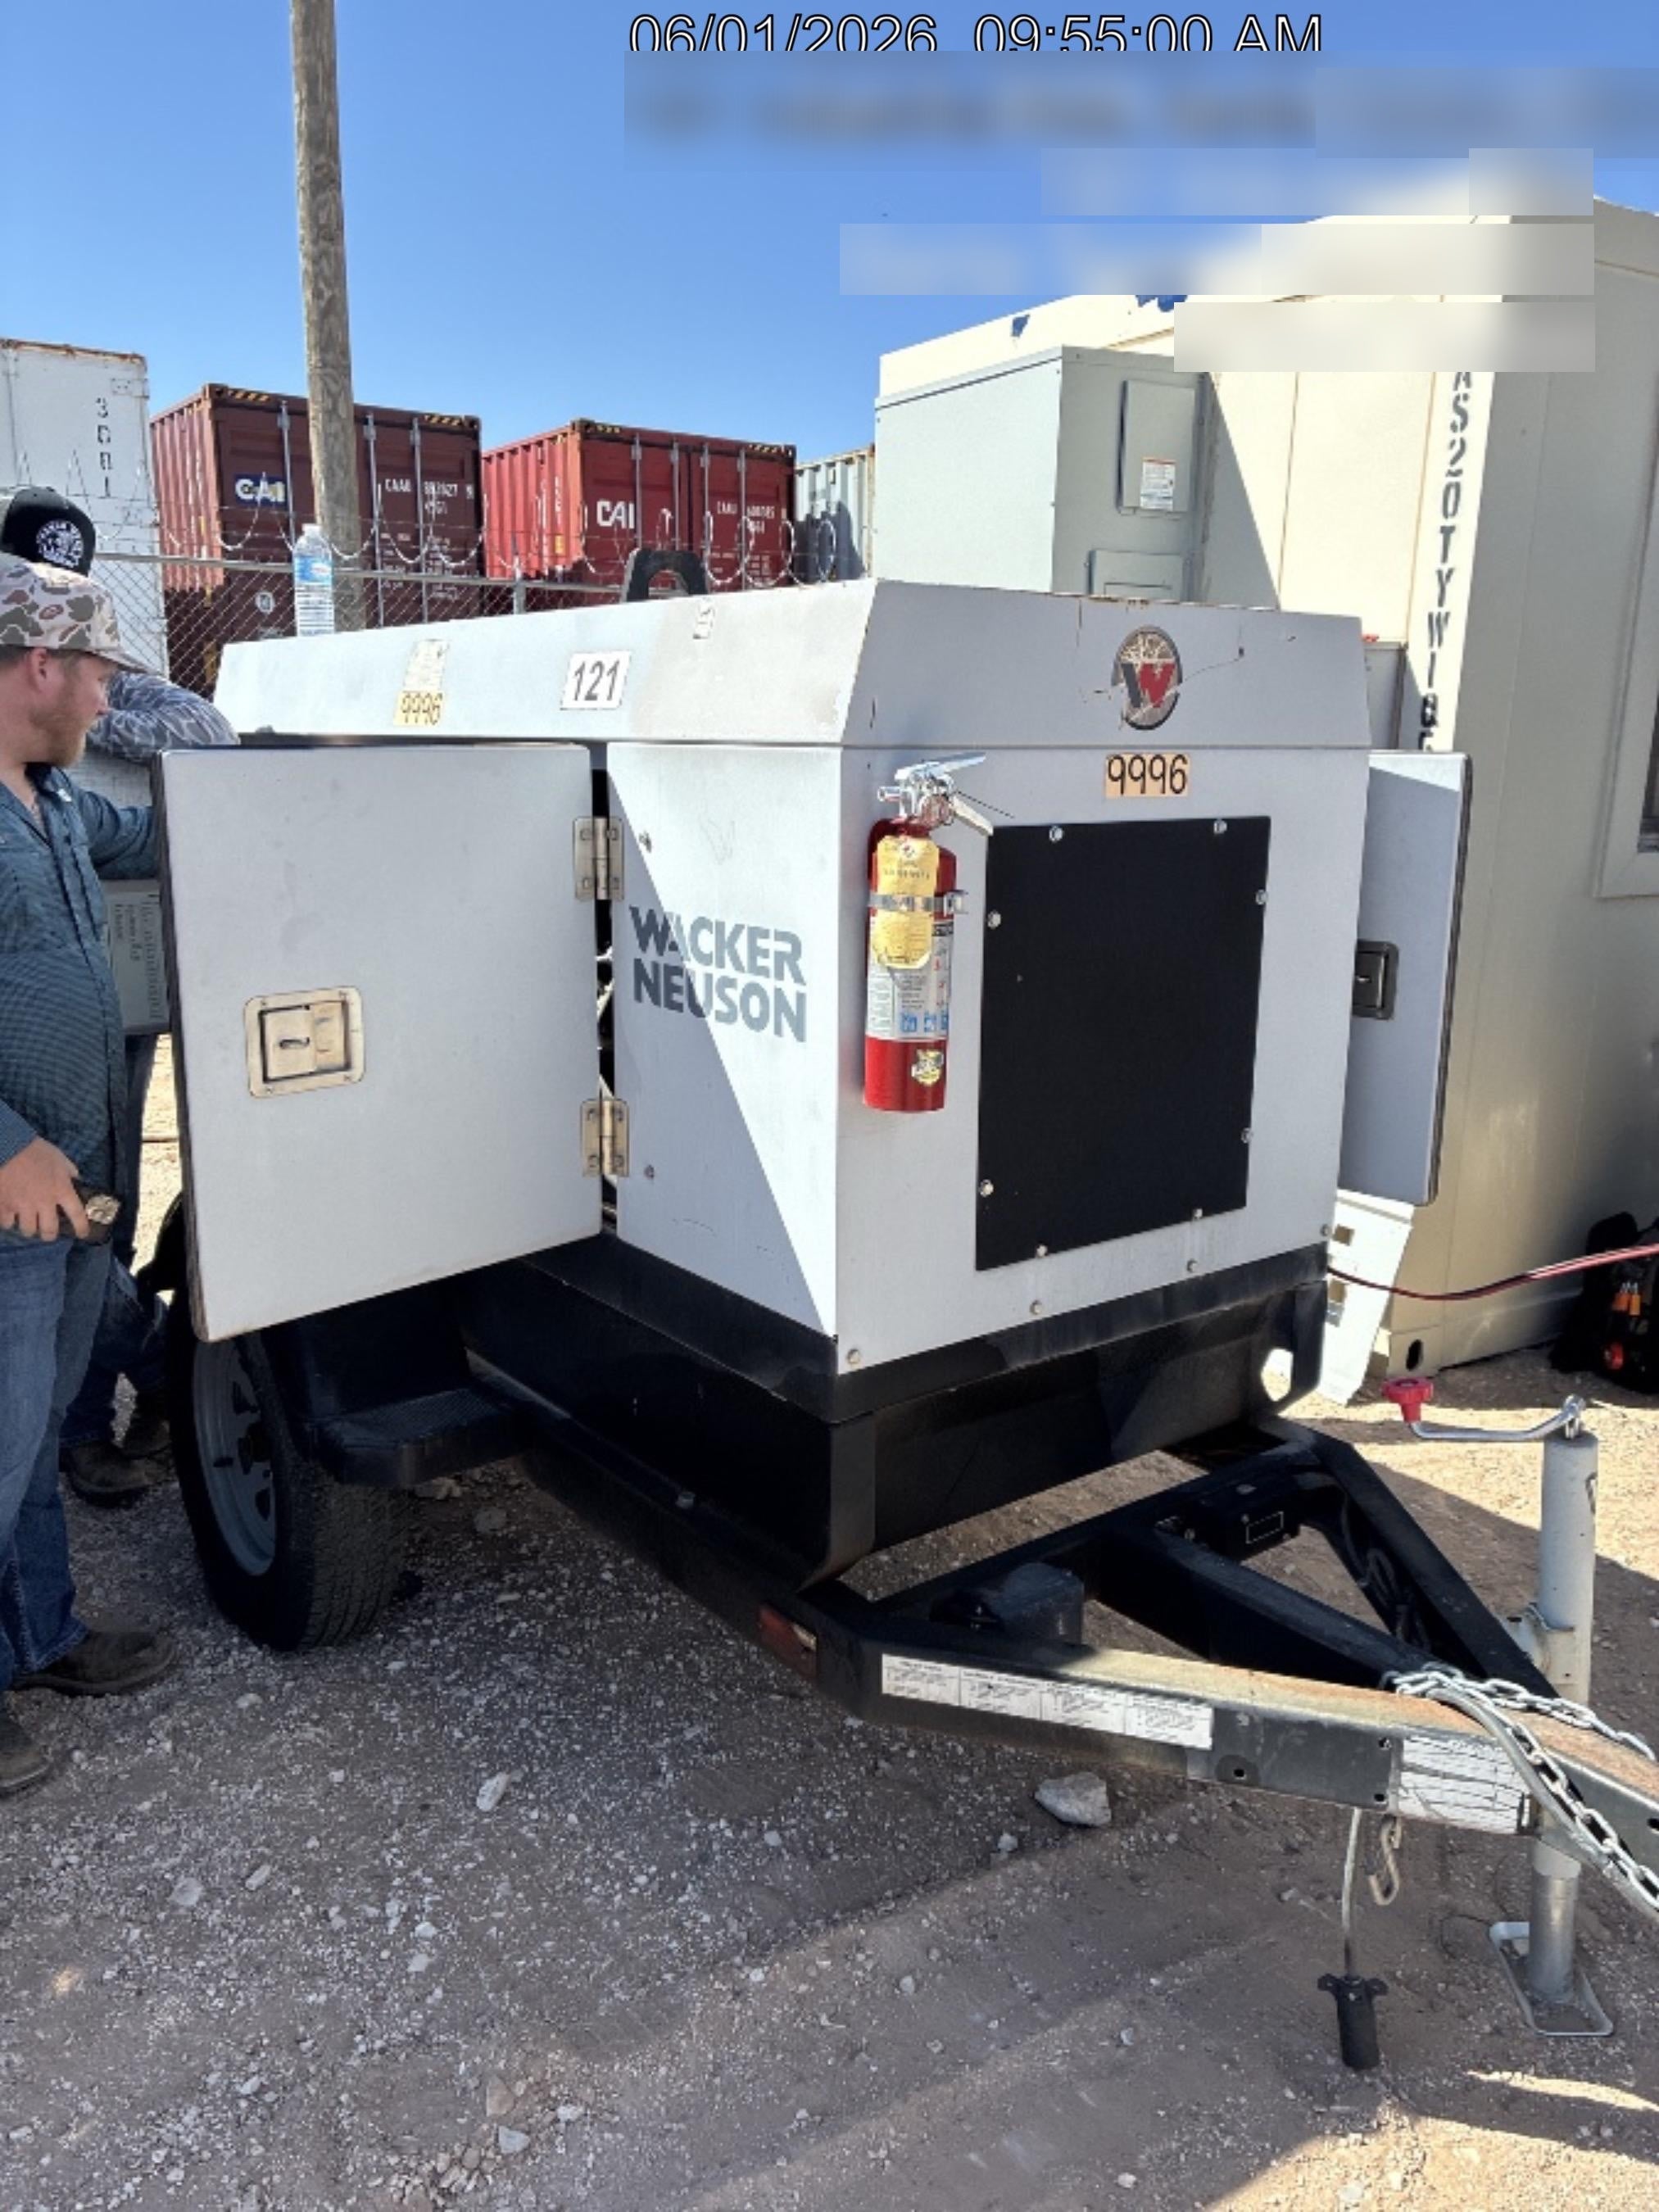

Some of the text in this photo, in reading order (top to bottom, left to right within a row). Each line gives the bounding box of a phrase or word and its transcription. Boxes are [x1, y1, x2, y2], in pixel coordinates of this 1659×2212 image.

[596, 500, 636, 529] CAI
[573, 660, 620, 701] 121
[1108, 754, 1188, 795] 9996
[628, 904, 807, 986] WACKER
[633, 958, 807, 1043] NEUSON
